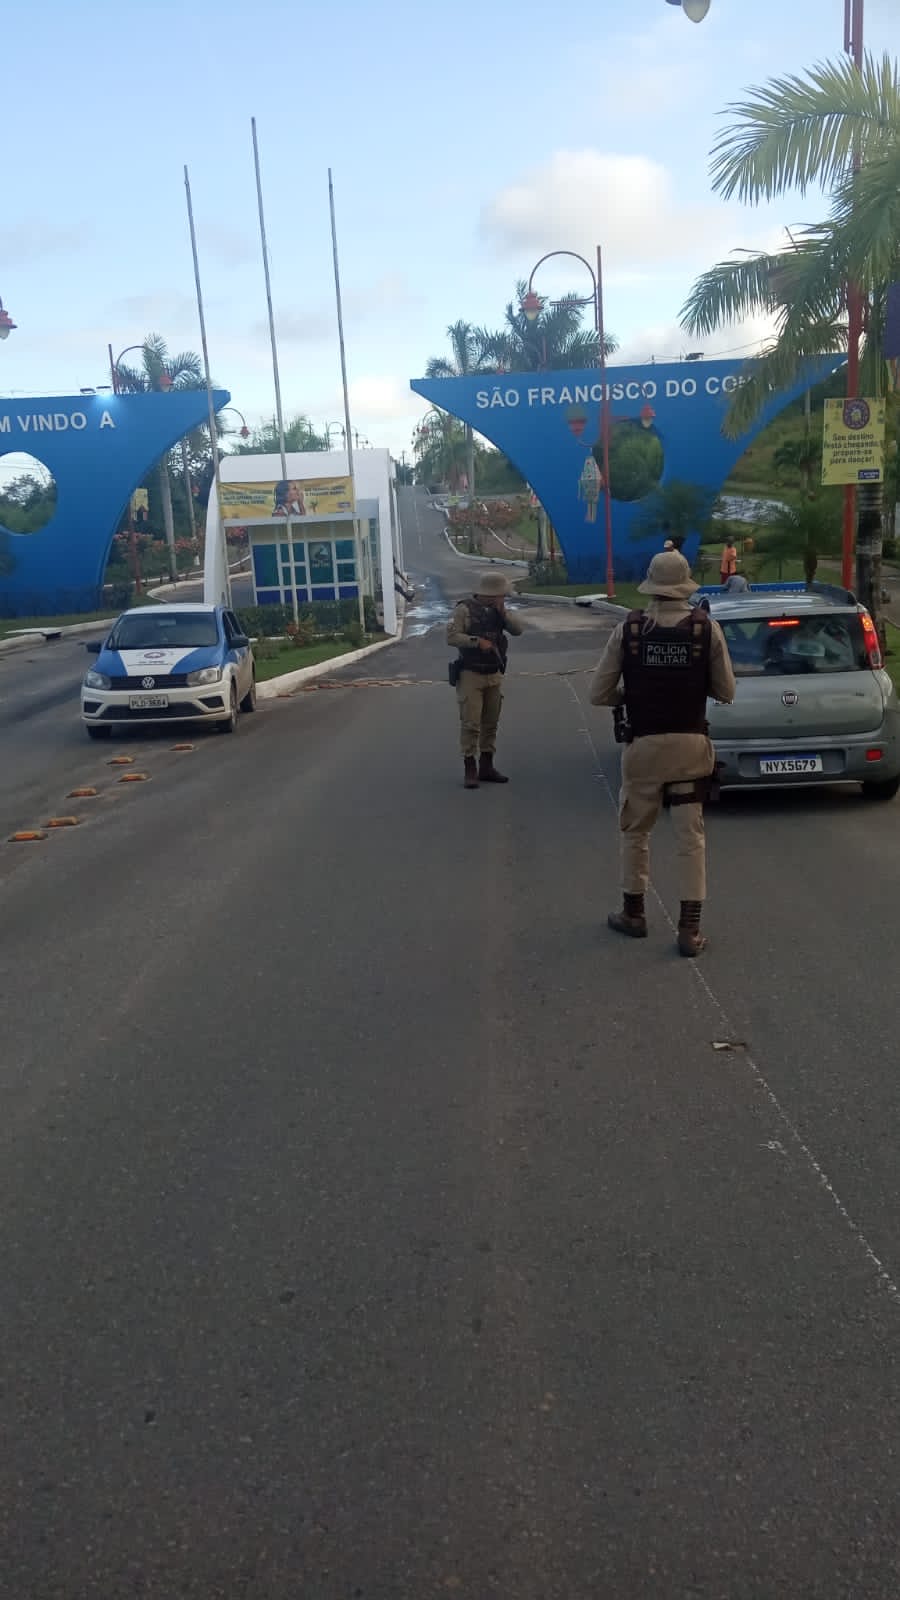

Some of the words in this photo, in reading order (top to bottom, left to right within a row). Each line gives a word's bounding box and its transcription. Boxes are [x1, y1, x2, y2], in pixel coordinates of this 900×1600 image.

[476, 386, 520, 408] SÃO
[528, 380, 657, 406] FRANCISCO
[665, 378, 697, 397] DO
[17, 412, 87, 432] VINDO
[100, 410, 116, 429] A
[647, 643, 688, 655] POLÍCIA
[647, 655, 688, 665] MILITAR
[766, 760, 817, 772] NYX5G79
